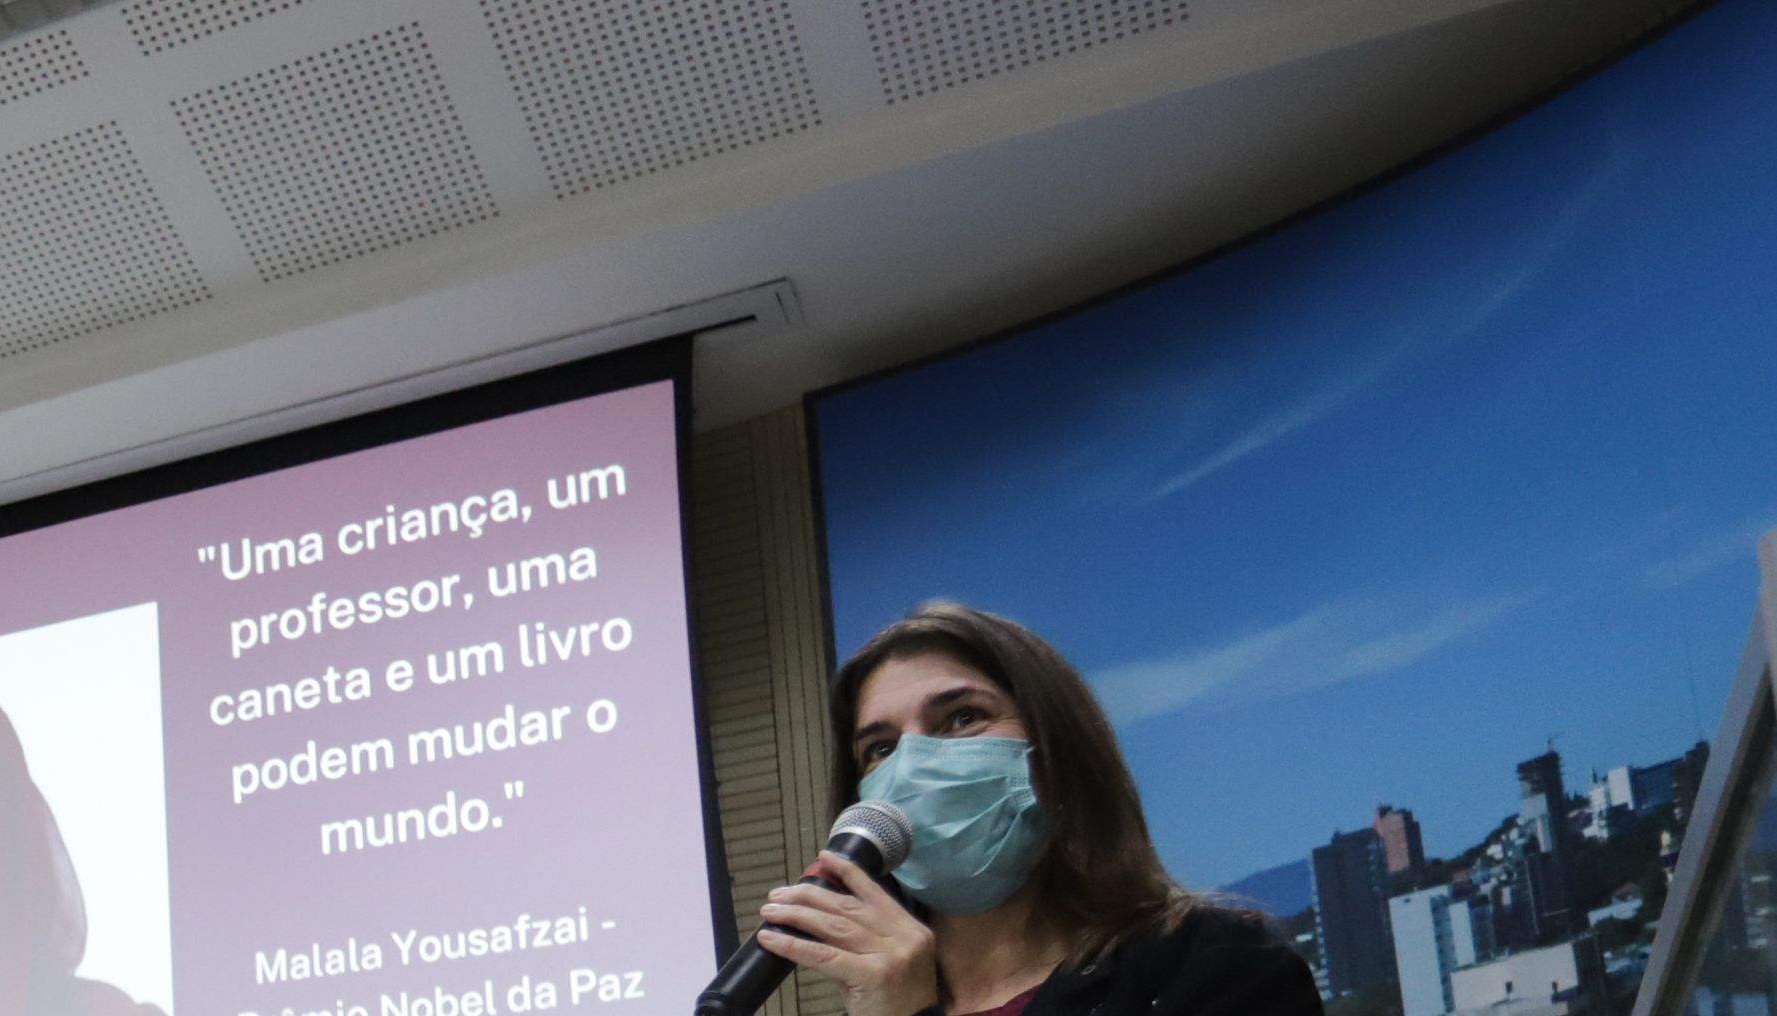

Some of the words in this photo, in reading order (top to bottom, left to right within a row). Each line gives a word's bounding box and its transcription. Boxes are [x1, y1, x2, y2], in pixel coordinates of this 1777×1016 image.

[197, 531, 324, 581] "Uma
[337, 487, 533, 555] criança,
[546, 463, 627, 510] um
[230, 573, 475, 659] professor,
[487, 546, 598, 598] uma
[209, 665, 372, 726] caneta
[385, 658, 415, 693] e
[426, 641, 504, 685] um
[518, 616, 633, 668] livro
[231, 739, 395, 804] podem
[407, 703, 571, 766] mudar
[585, 698, 618, 733] o
[320, 780, 525, 855] mundo."
[254, 937, 383, 985] Malala
[390, 905, 589, 966] Yousafzai
[506, 974, 557, 1014] da
[568, 967, 646, 1006] Paz
